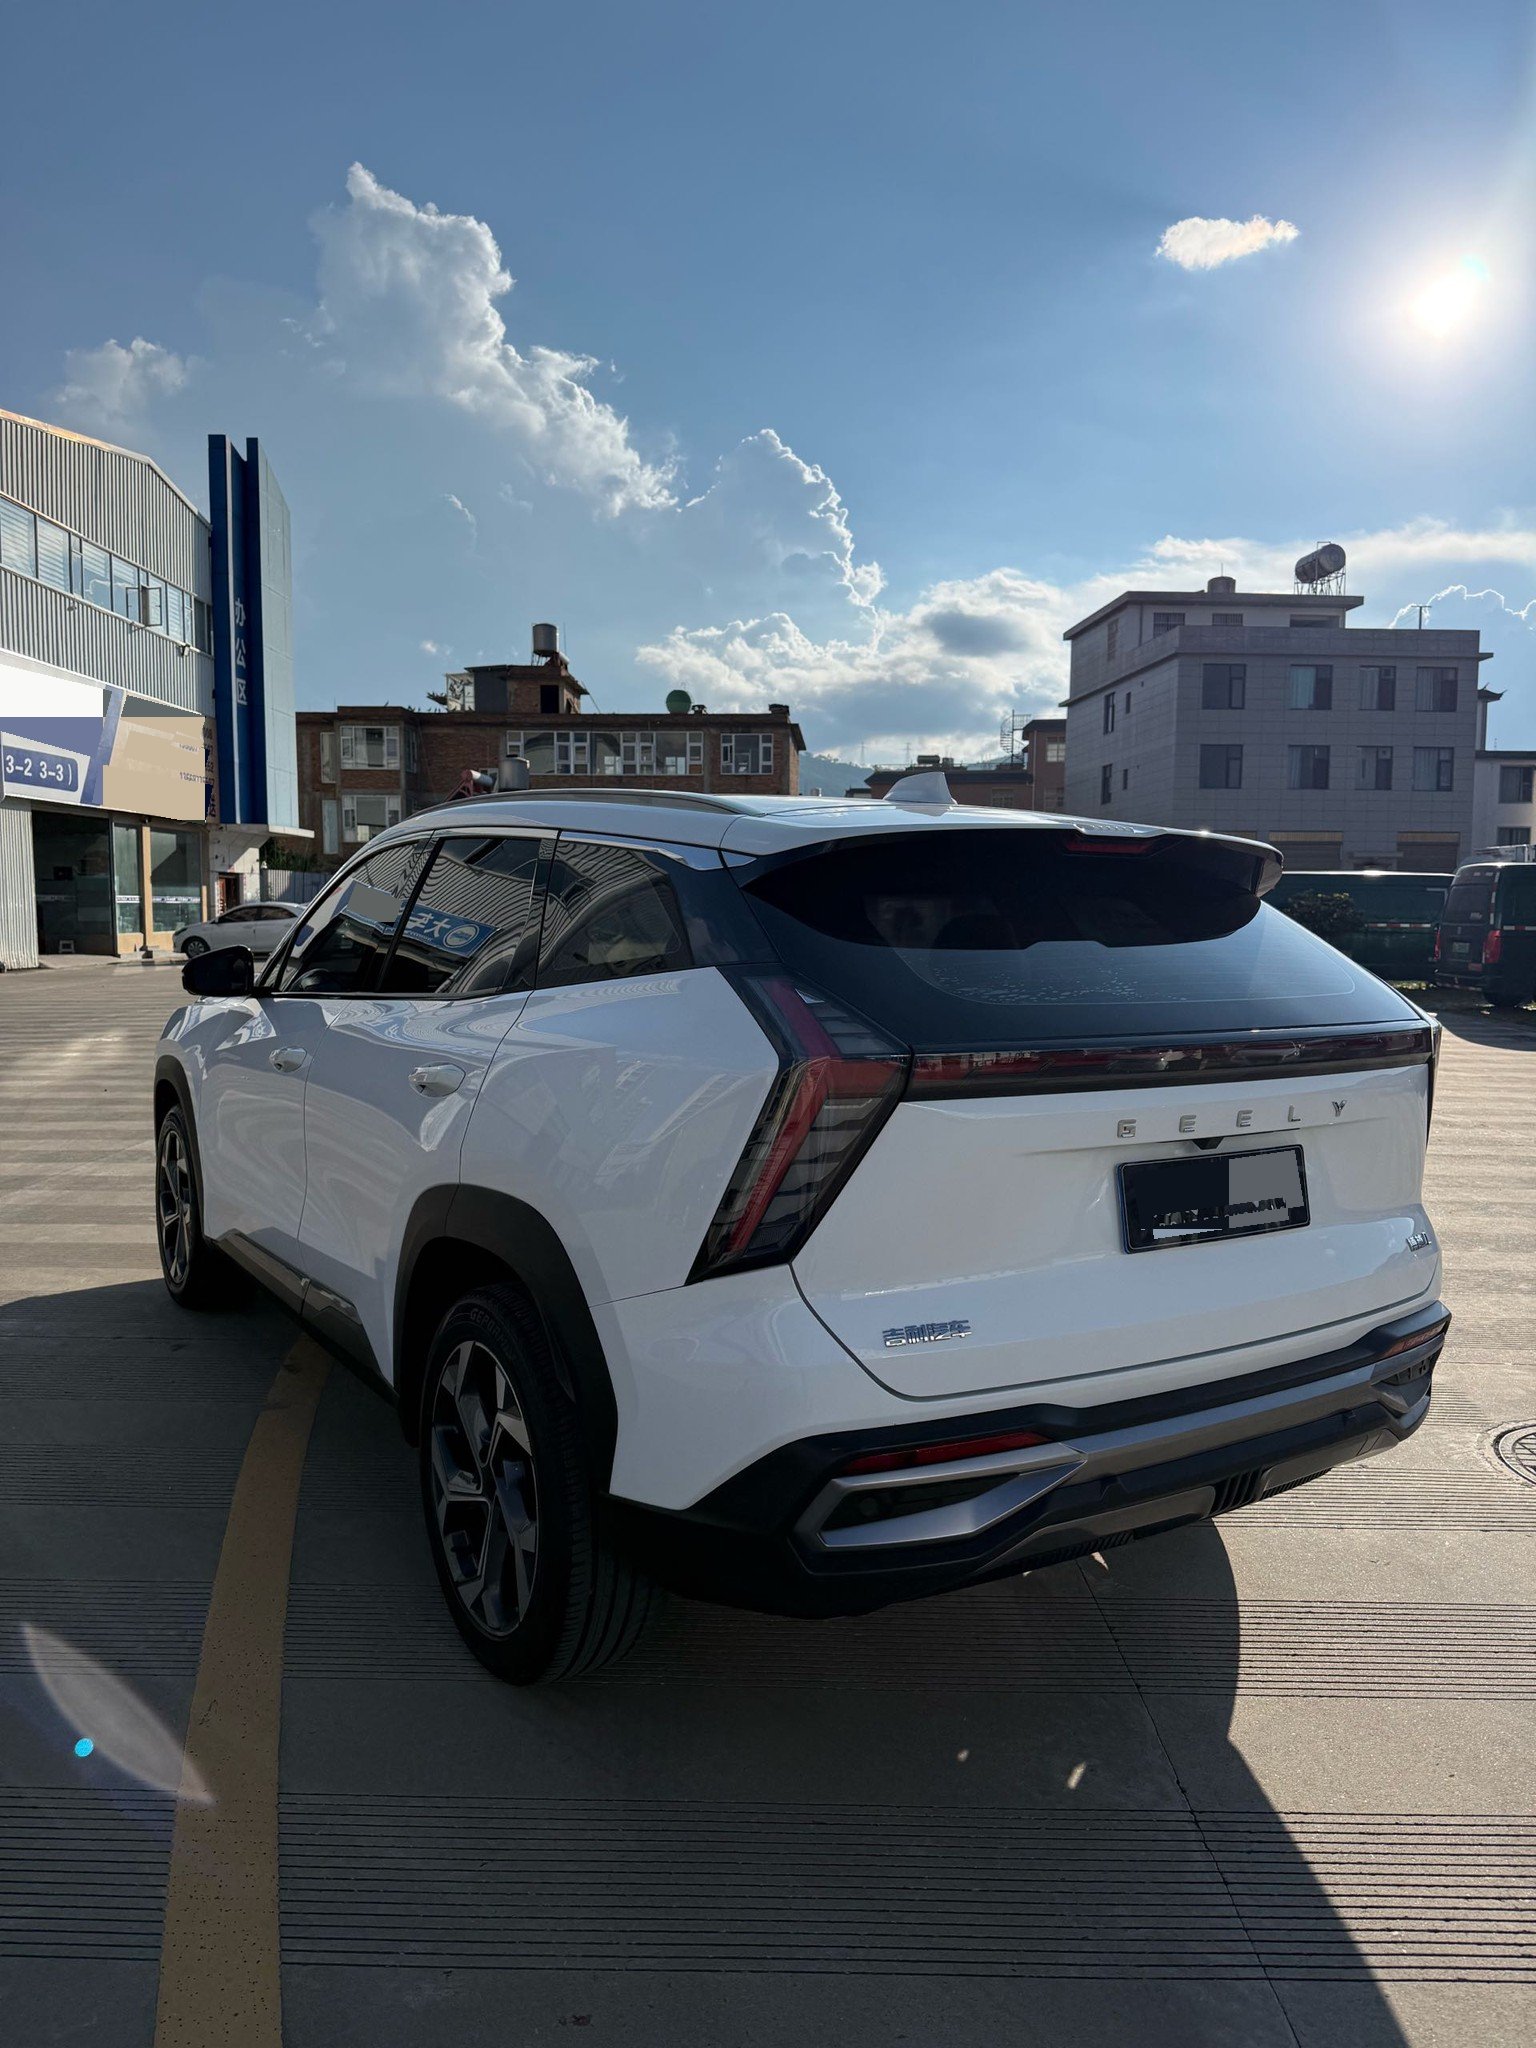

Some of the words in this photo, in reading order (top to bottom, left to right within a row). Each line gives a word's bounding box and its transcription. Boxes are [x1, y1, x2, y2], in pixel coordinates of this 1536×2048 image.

[234, 597, 248, 705] 办公区
[1116, 1099, 1348, 1139] GEELY
[881, 1319, 973, 1347] 吉利汽车
